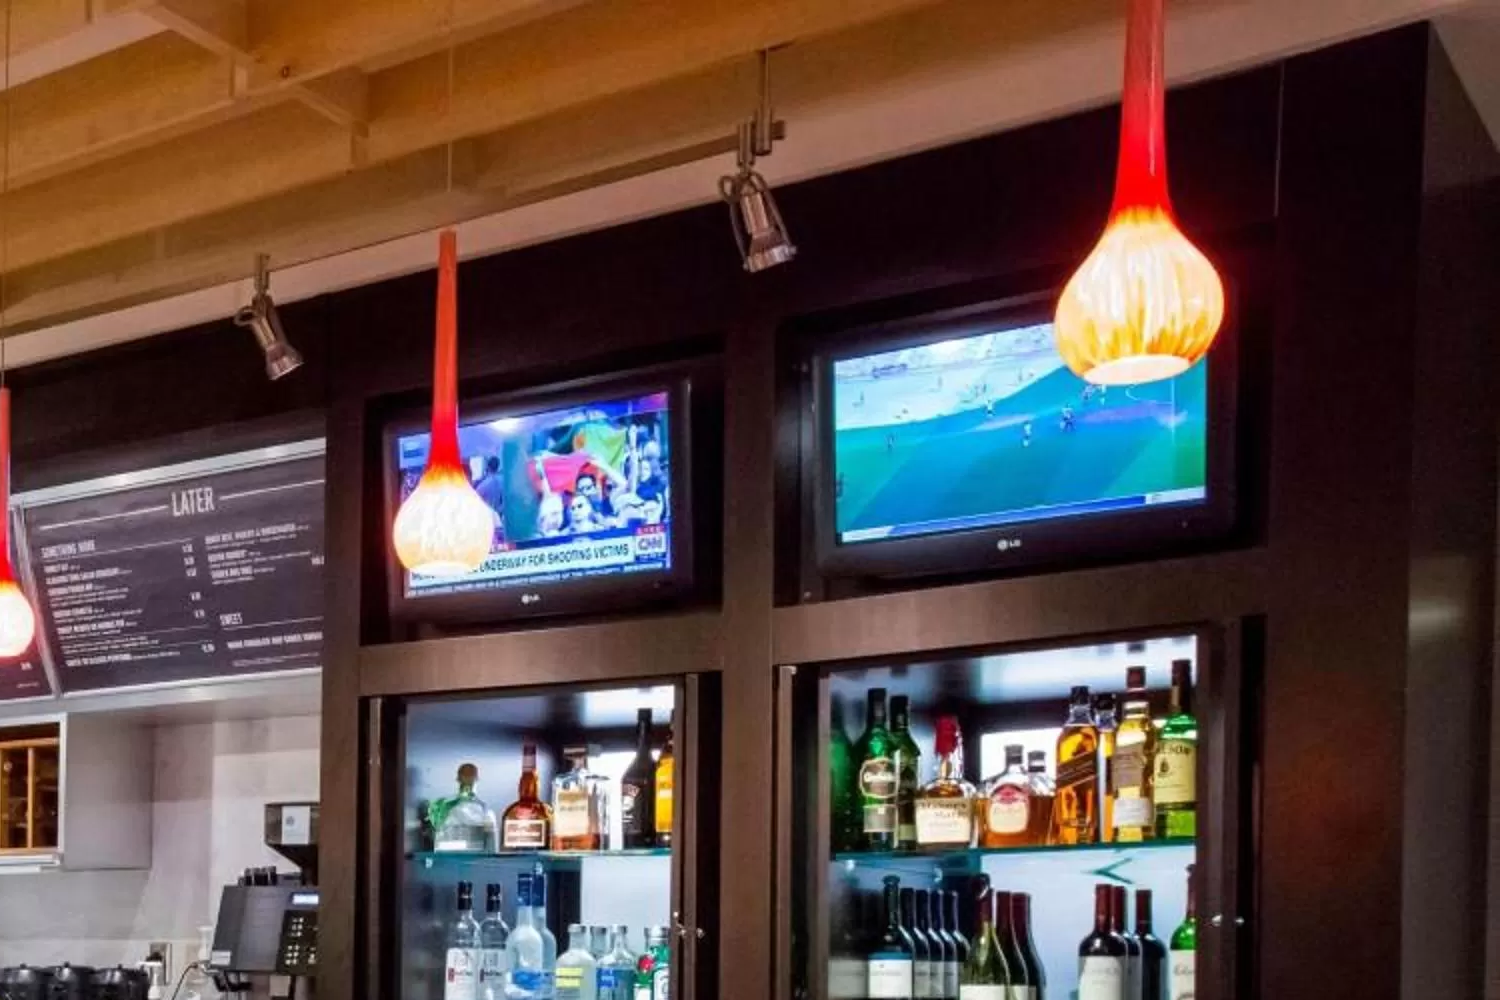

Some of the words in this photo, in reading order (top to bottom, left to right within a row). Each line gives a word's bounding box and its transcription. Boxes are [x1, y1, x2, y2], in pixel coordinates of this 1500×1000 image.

[170, 487, 215, 517] LATER
[480, 557, 527, 574] UNDERWAY
[528, 553, 545, 567] FOR
[547, 548, 592, 565] SHOOTING
[593, 543, 629, 559] VICTIMS
